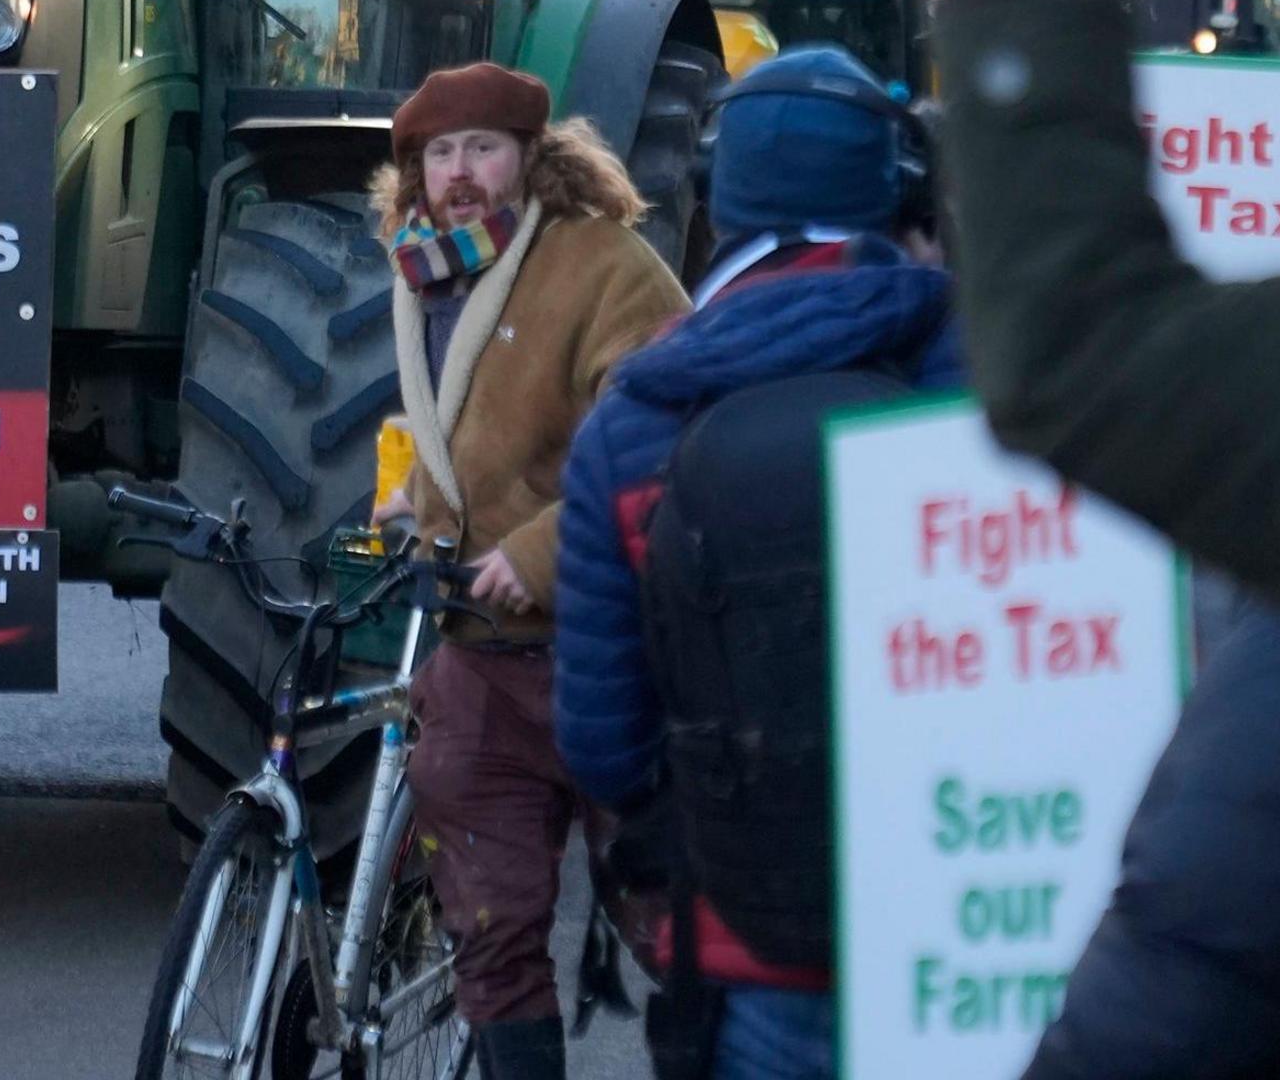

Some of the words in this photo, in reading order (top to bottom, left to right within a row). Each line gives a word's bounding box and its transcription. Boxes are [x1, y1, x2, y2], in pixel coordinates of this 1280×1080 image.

[1140, 115, 1275, 175] ight
[918, 484, 1081, 586] Fight
[888, 615, 983, 694] the
[1006, 602, 1123, 683] Tax
[933, 776, 1083, 855] Save
[957, 883, 1062, 941] our
[912, 960, 1066, 1036] Farm
